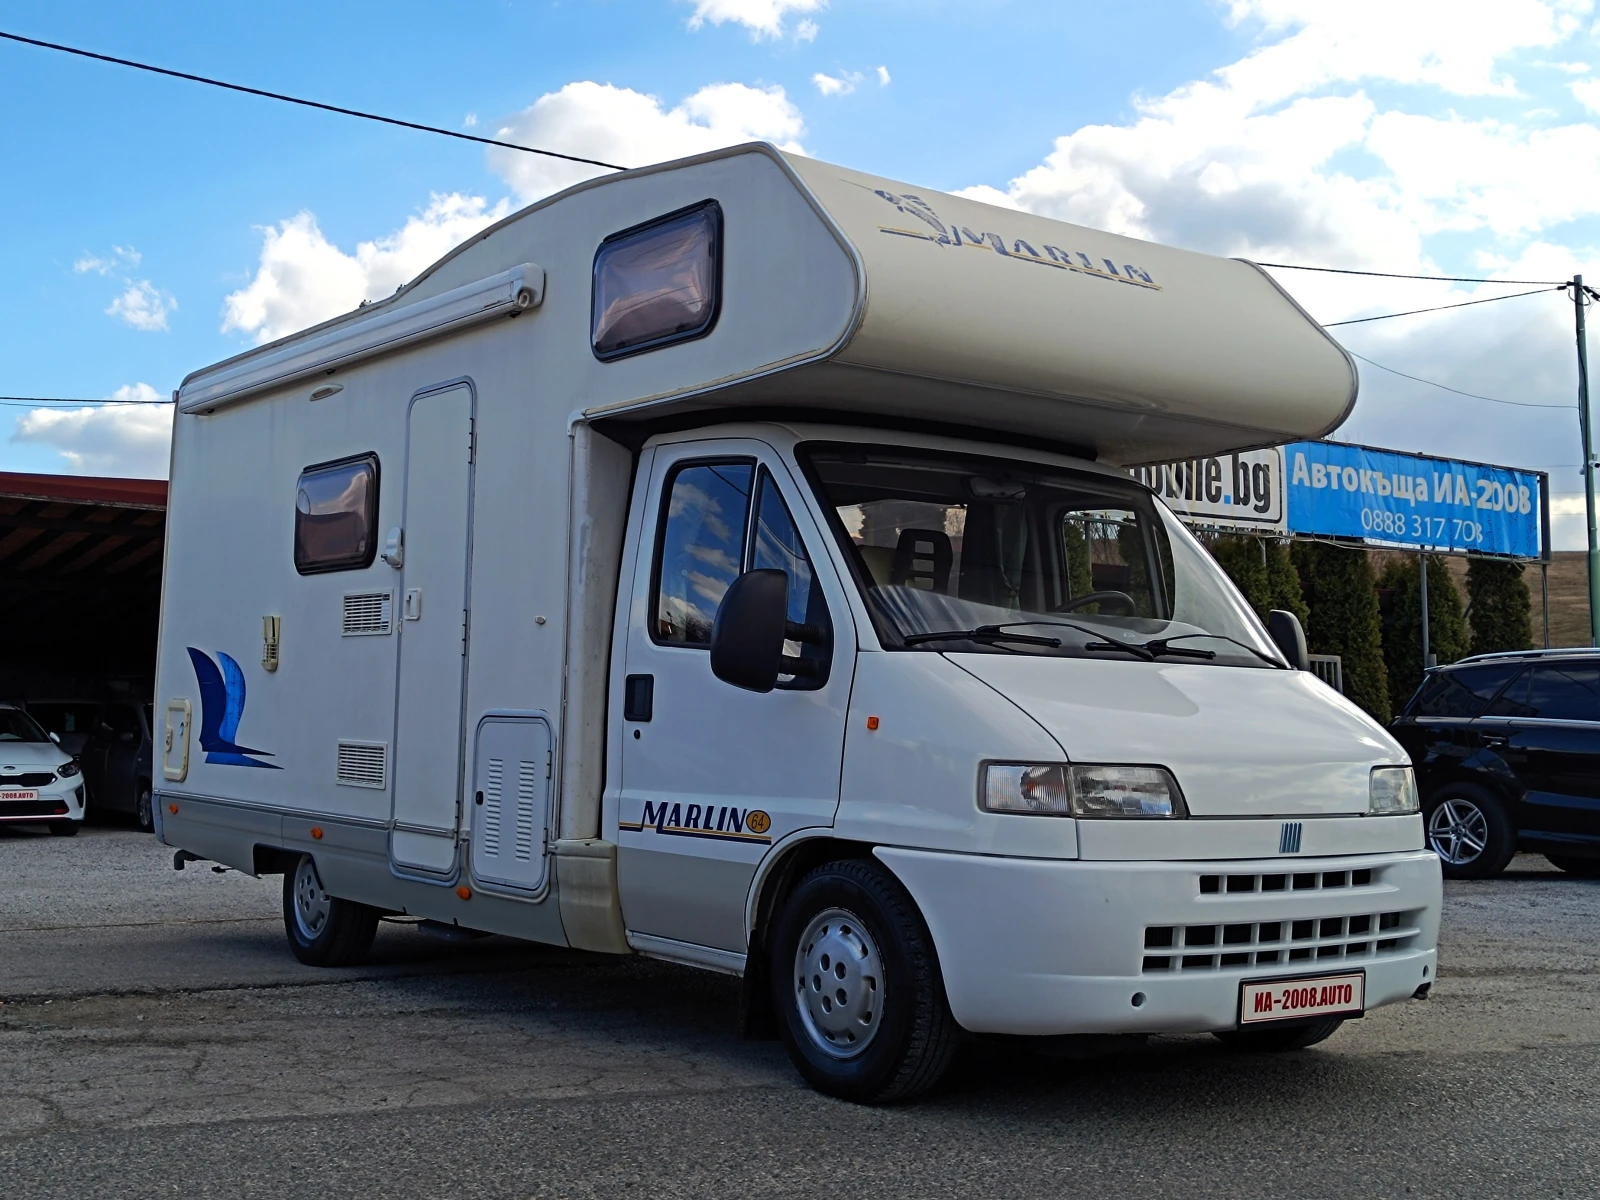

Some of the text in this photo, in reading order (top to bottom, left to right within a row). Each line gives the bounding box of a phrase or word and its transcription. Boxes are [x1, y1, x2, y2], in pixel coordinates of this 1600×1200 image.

[1292, 452, 1531, 515] Автокъща ИА-2008
[1361, 508, 1483, 543] 0888 317 708
[640, 800, 764, 834] MARLIN 64
[1254, 984, 1352, 1013] ИА-2008.AUTO
